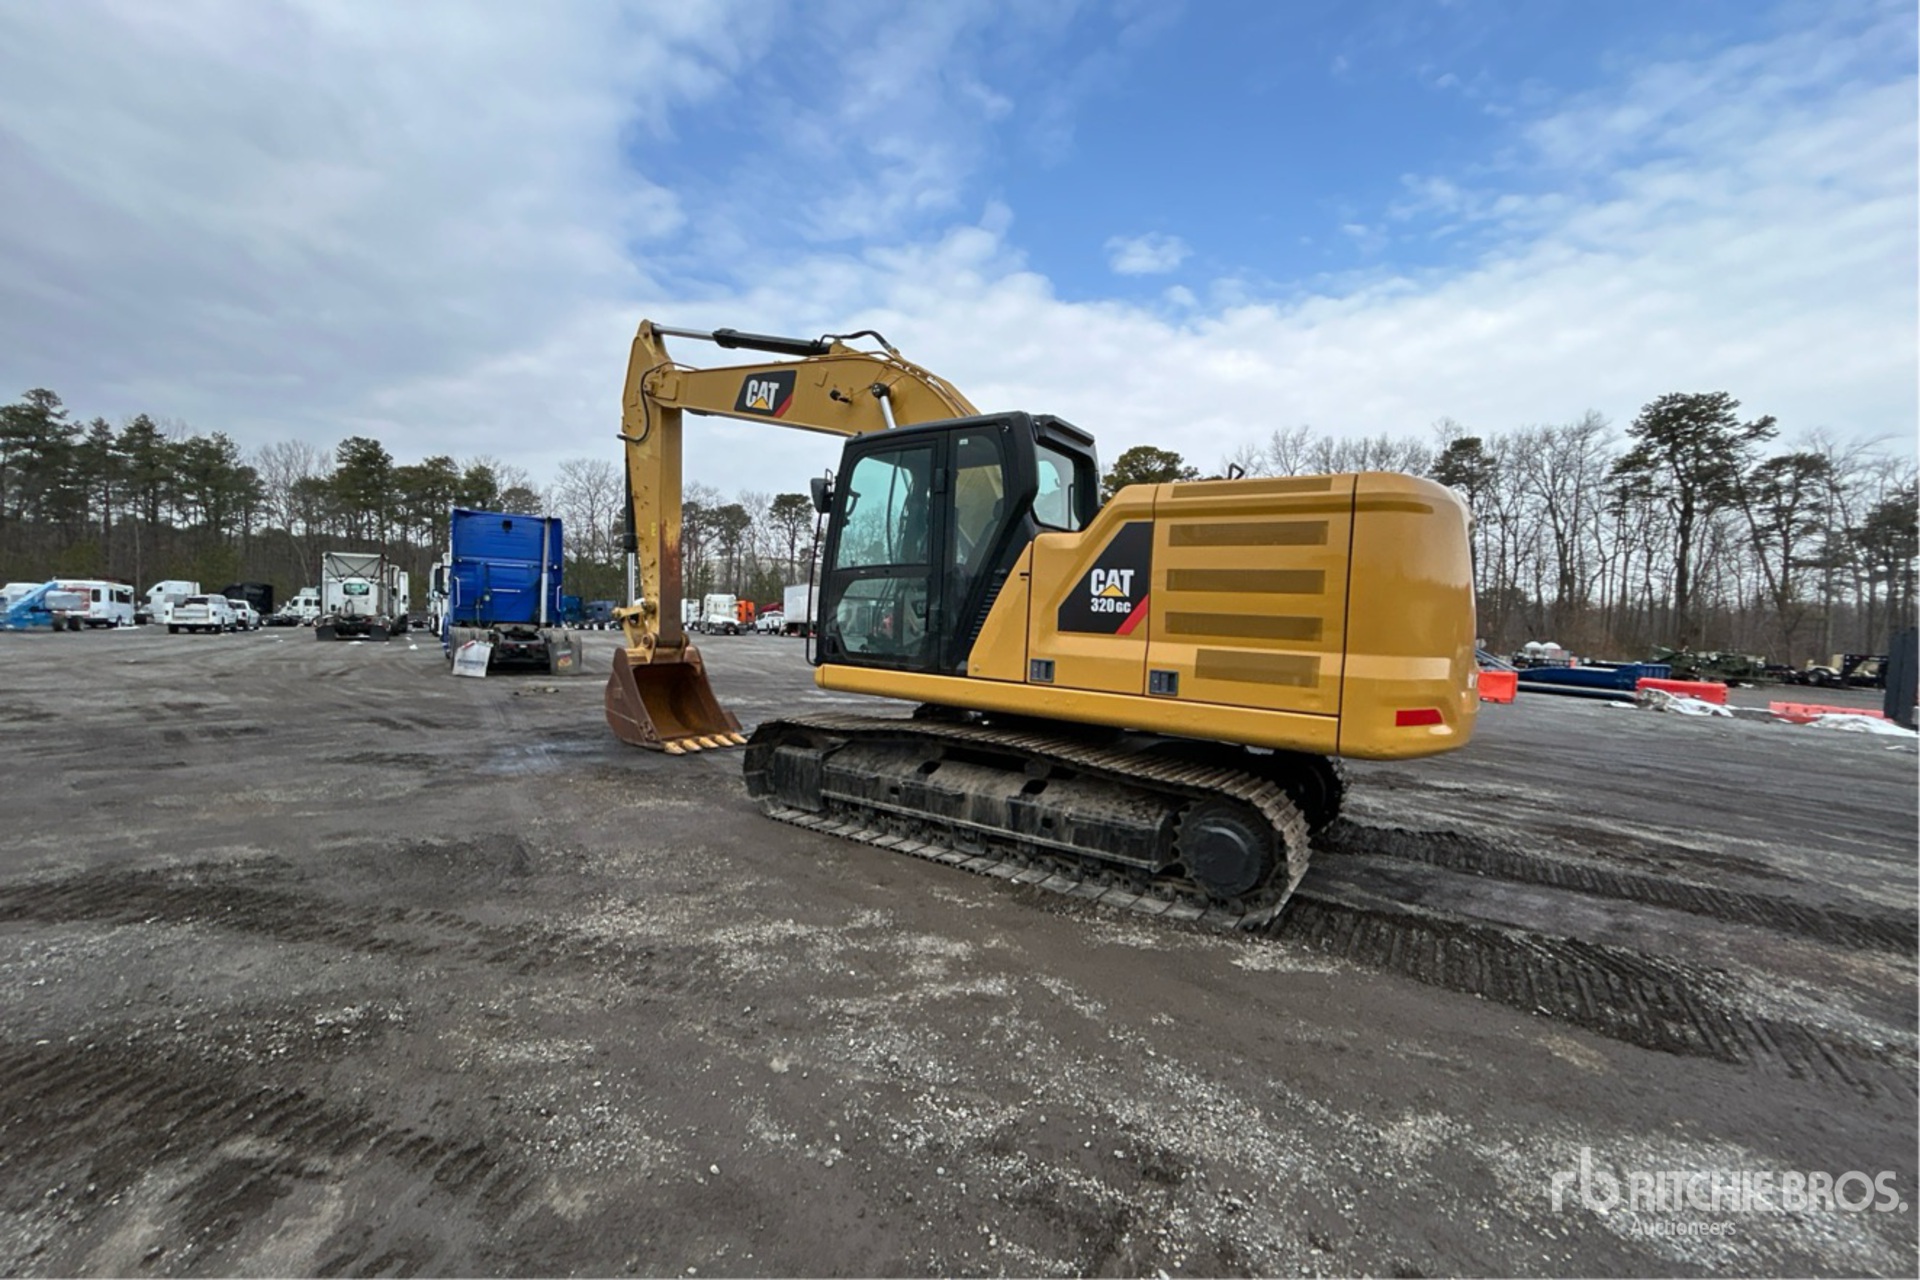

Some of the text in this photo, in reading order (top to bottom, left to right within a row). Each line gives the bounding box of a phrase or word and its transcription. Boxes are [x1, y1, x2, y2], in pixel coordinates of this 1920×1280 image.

[745, 379, 780, 411] CAT
[1090, 568, 1135, 597] CAT
[1091, 598, 1115, 612] 320
